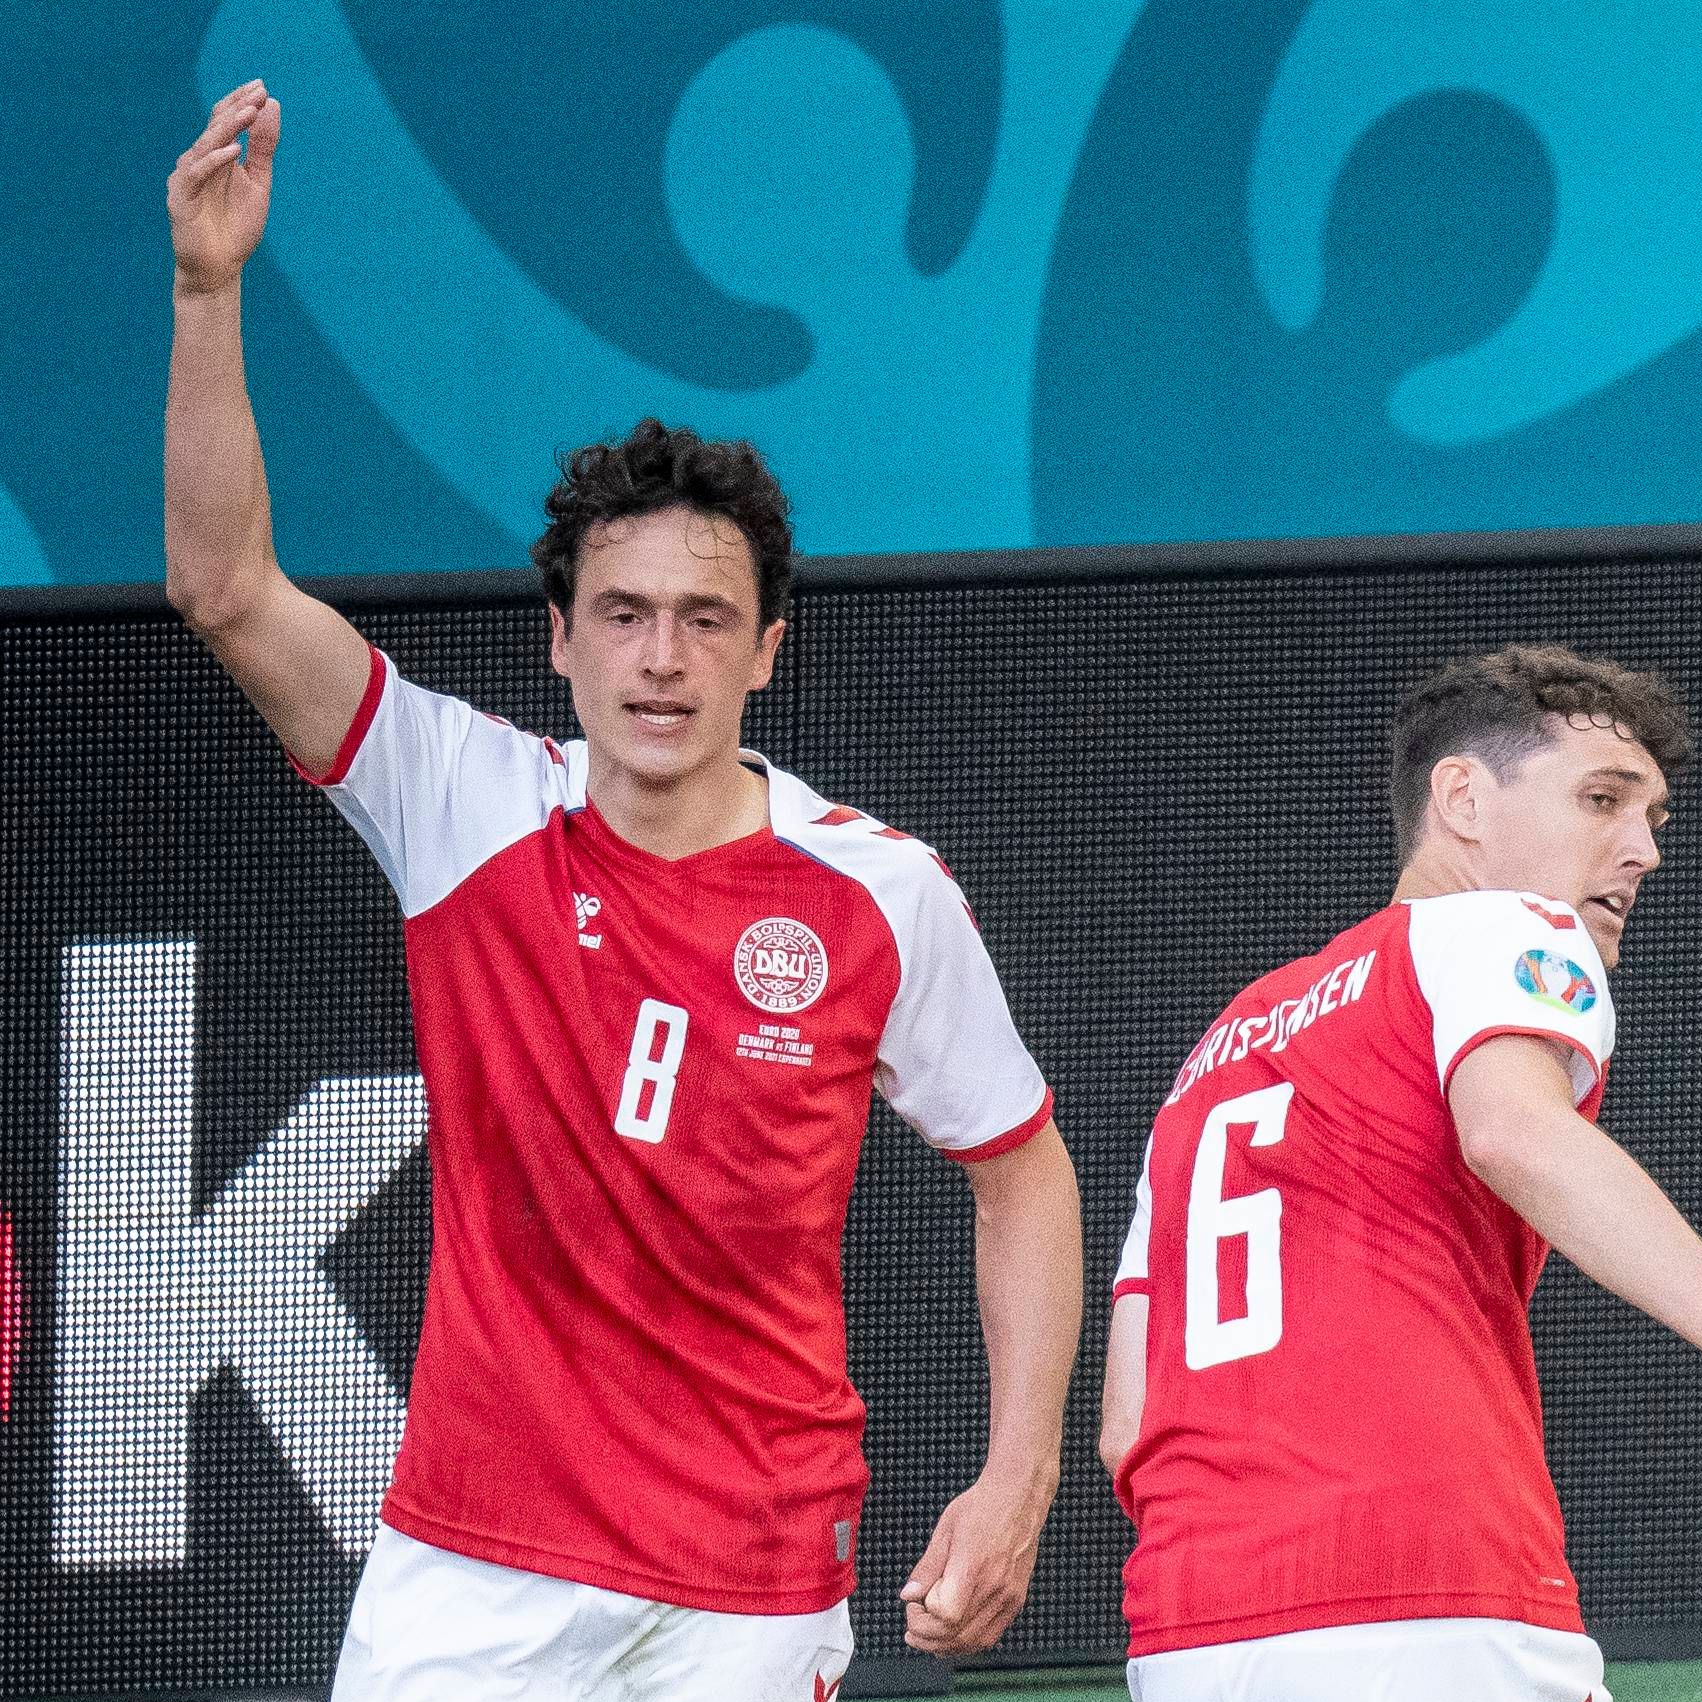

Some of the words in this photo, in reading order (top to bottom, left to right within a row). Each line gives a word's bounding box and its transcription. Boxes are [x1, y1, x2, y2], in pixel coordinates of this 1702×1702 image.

[754, 949, 807, 980] DBU
[760, 992, 798, 1009] 1889
[614, 998, 690, 1145] 8
[0, 936, 432, 1564] k
[1184, 1080, 1296, 1371] 6
